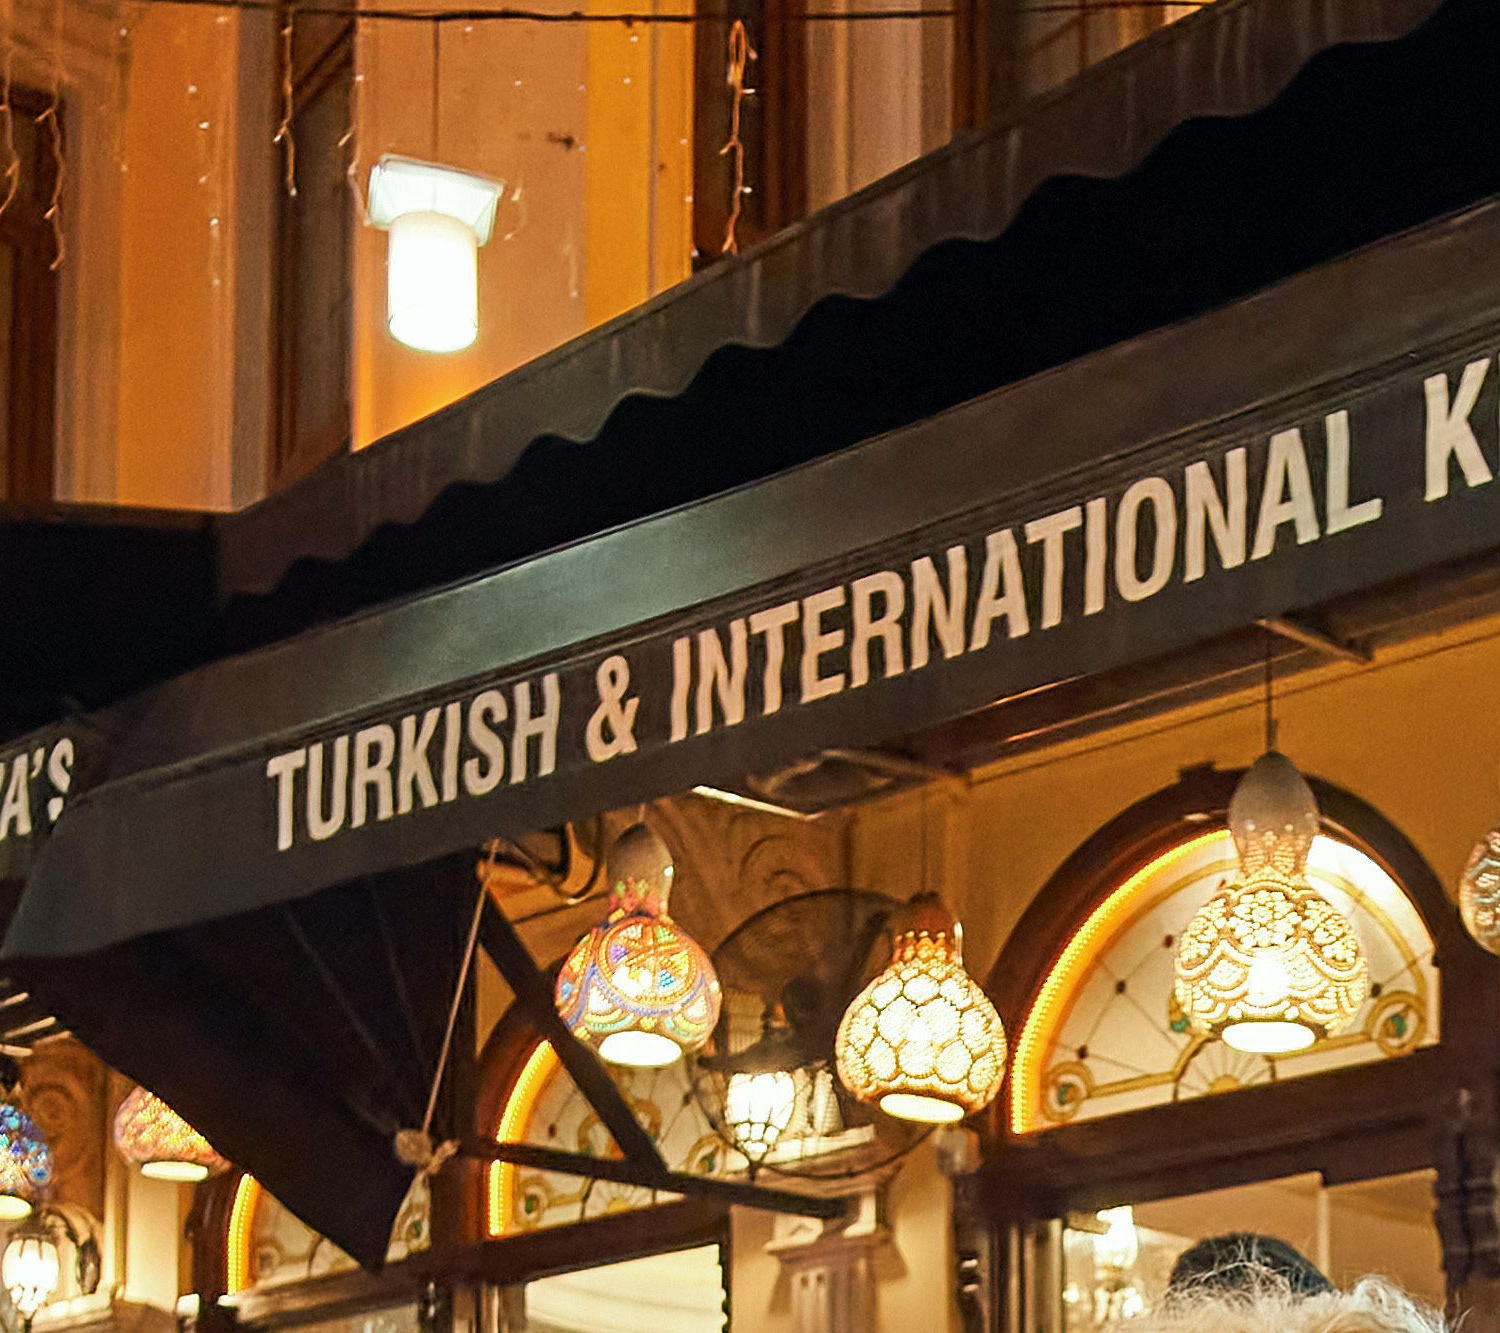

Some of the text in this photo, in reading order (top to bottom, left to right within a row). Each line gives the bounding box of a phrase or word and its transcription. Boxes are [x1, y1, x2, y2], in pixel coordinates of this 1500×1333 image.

[266, 670, 560, 853] TURKISH
[586, 652, 640, 765] &
[669, 409, 1383, 744] INTERNATIONAL
